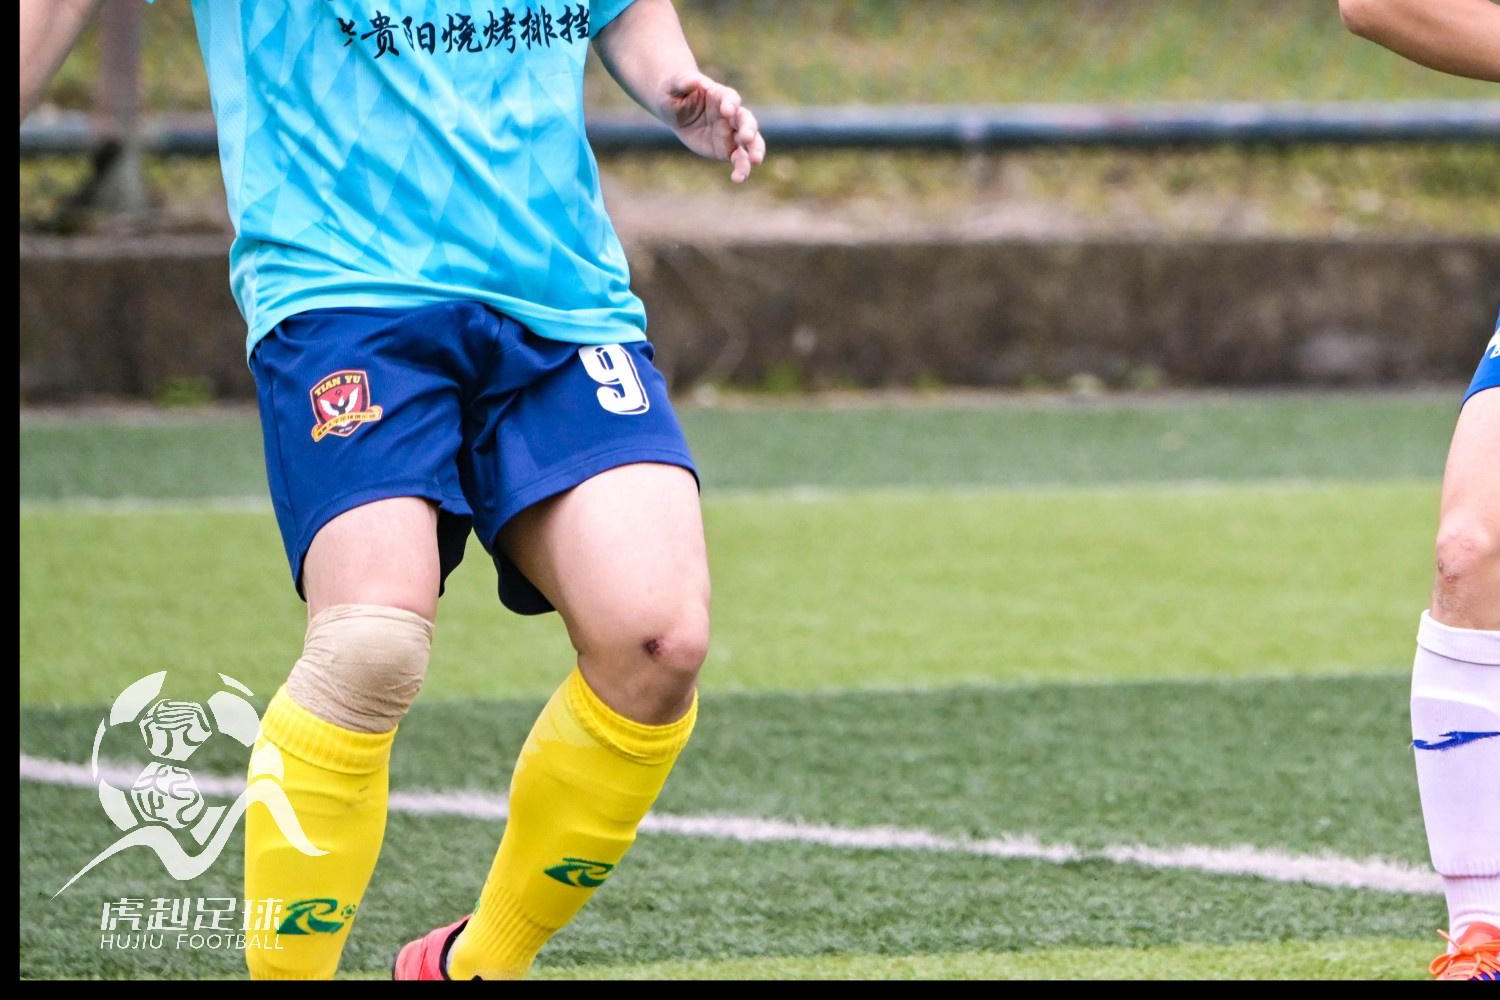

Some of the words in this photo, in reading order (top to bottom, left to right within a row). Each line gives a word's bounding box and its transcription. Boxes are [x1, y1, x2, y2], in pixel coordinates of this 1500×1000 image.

[314, 376, 341, 396] TIAN
[344, 375, 361, 384] YU
[577, 344, 650, 415] 9
